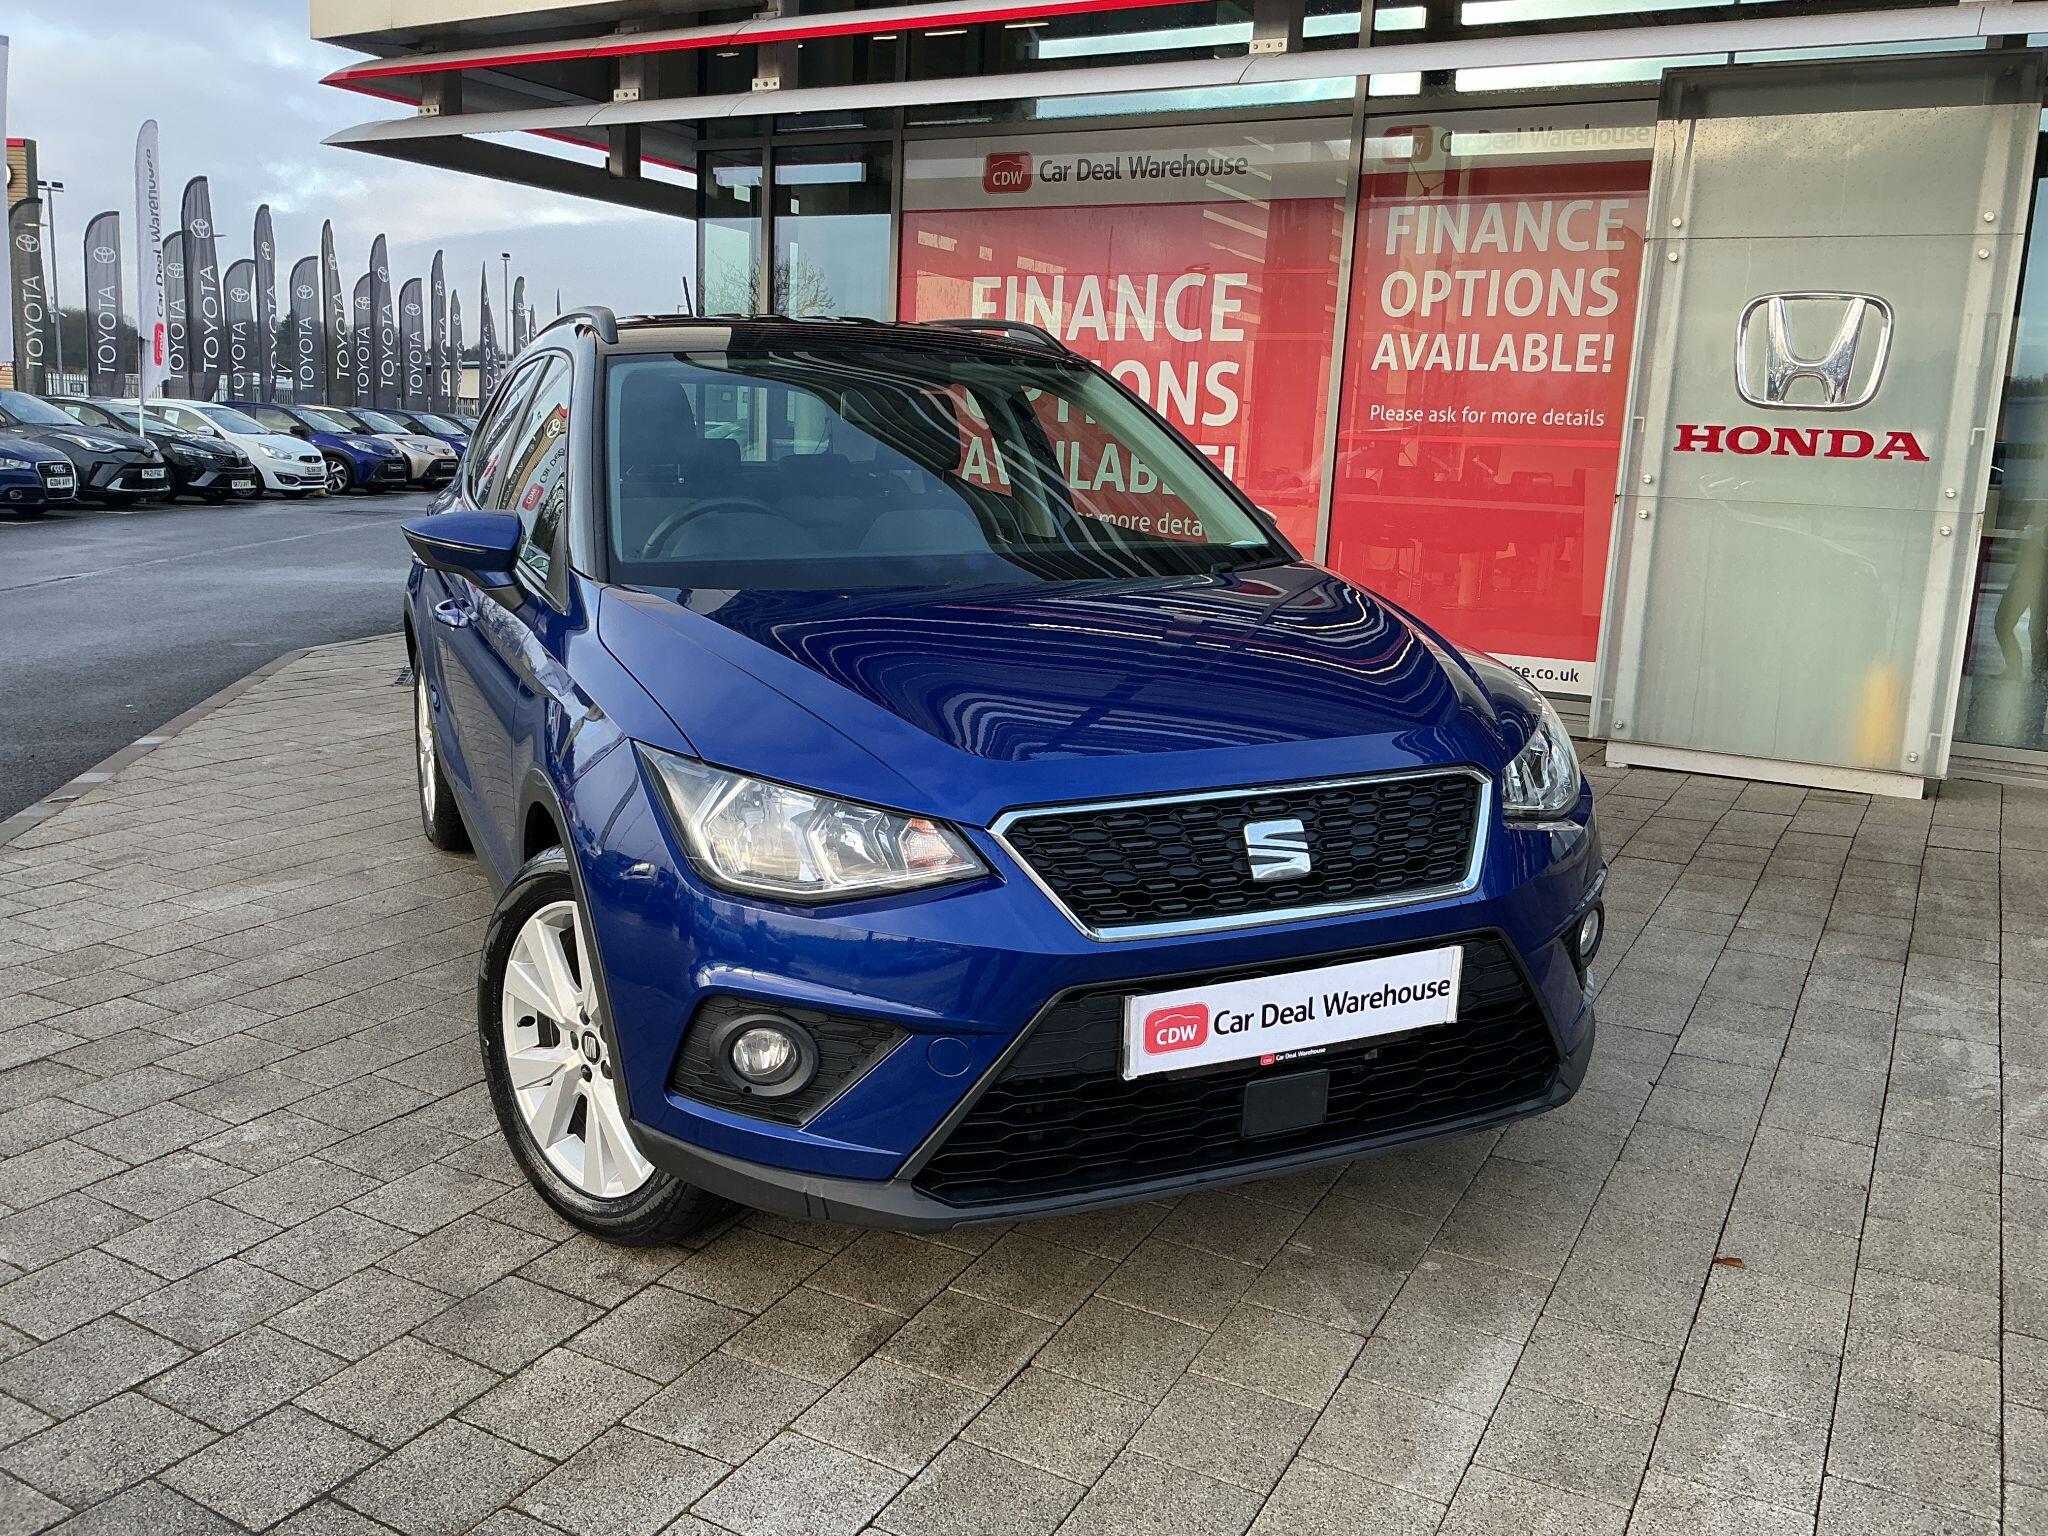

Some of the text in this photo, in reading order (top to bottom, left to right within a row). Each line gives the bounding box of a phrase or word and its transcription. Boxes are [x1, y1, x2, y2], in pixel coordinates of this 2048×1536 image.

[992, 153, 1249, 186] CDW Car Deal Warehouse
[1530, 123, 1649, 147] Warehouse
[1385, 200, 1629, 255] FINANCE
[153, 249, 163, 286] Deal
[1380, 267, 1621, 318] OPTIONS
[23, 275, 43, 369] TOYOTA
[98, 285, 116, 374] TOYOTA
[169, 299, 185, 380] TOYOTA
[200, 265, 219, 373] TOYOTA
[267, 286, 277, 384] TOYOTA
[333, 292, 350, 379] TOYOTA
[971, 272, 1249, 343] FINANCE
[299, 317, 315, 390] TOYOTA
[357, 326, 371, 396] TOYOTA
[381, 304, 395, 388] TOYOTA
[409, 331, 423, 396] TOYOTA
[439, 317, 450, 396] TOYOTA
[1370, 333, 1614, 373] AVAILABLE!
[1370, 404, 1605, 427] Please ask for more details
[1673, 424, 1930, 461] HONDA
[1156, 978, 1450, 1046] CDW Car Deal Warehouse
[1285, 1052, 1297, 1060] Deal
[1298, 1047, 1326, 1057] Warehouse
